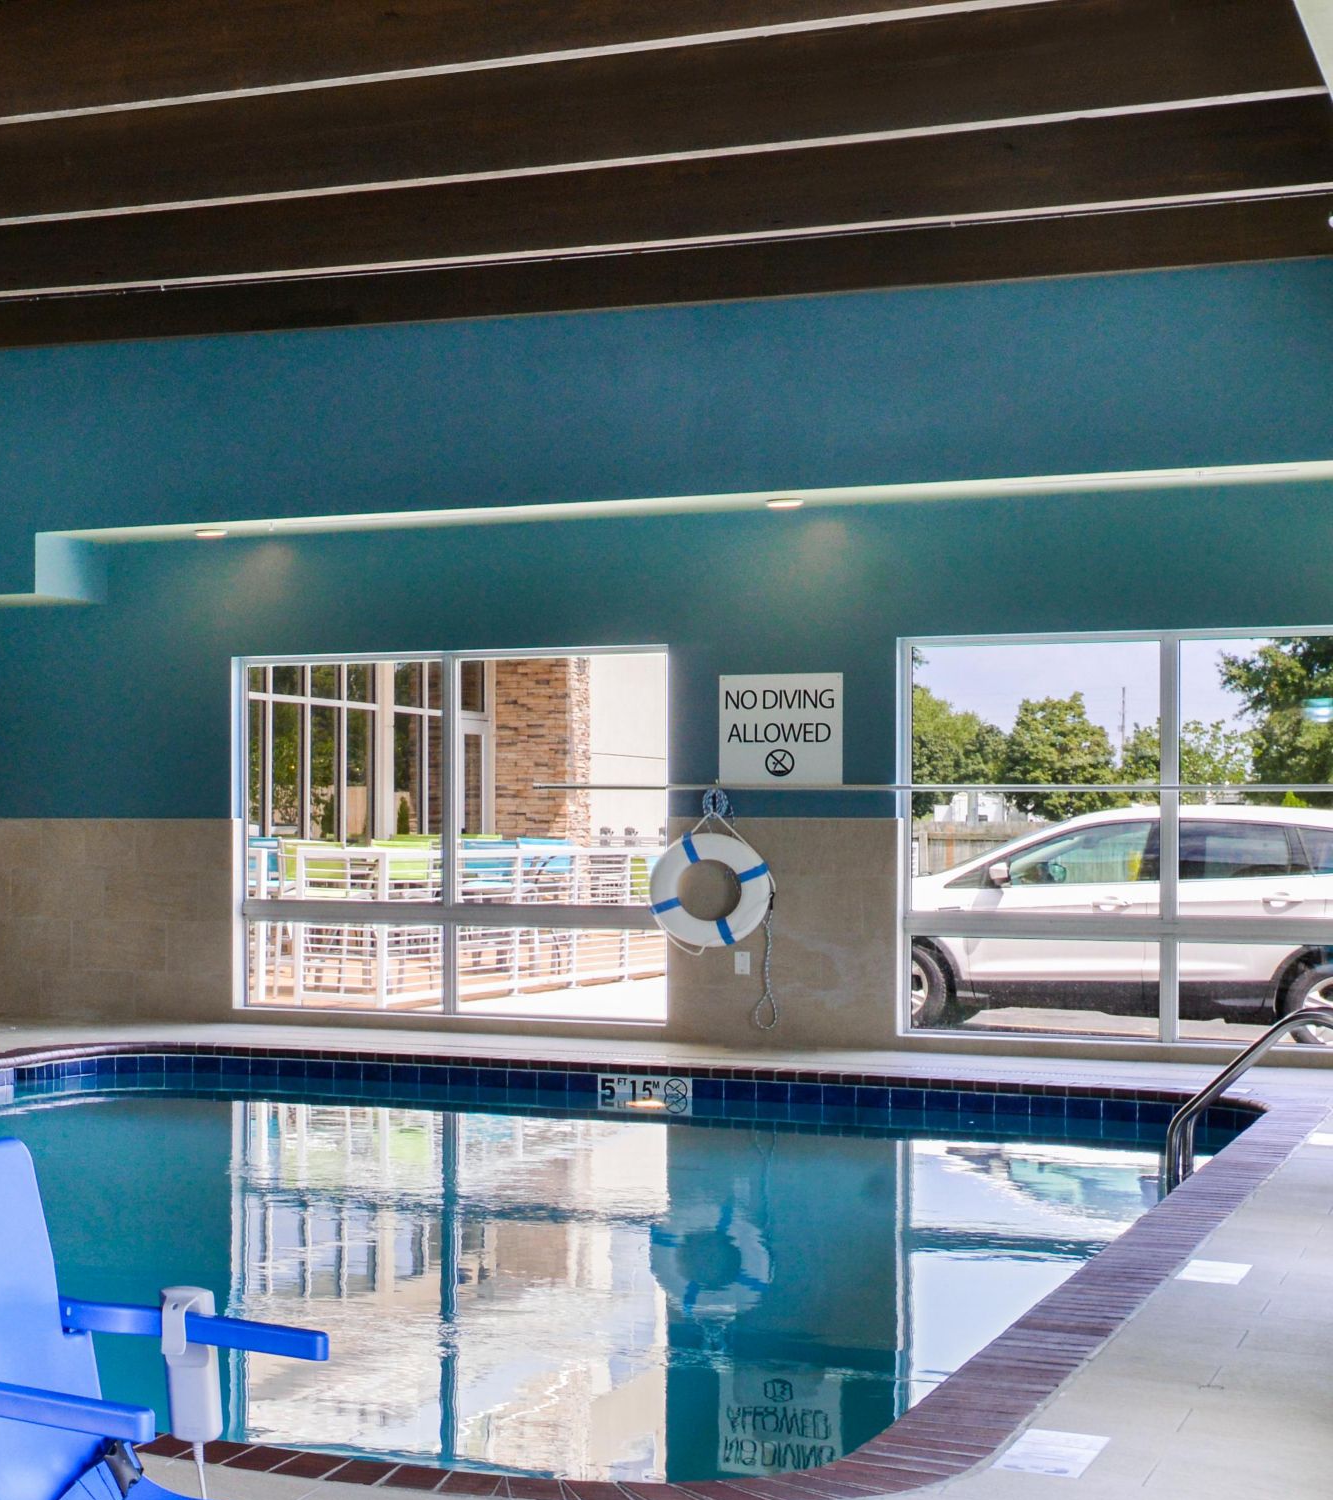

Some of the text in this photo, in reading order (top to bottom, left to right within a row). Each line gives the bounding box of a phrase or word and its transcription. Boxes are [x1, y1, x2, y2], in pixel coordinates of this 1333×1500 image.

[725, 689, 834, 710] NO DIVING
[727, 723, 831, 743] ALLOWED
[618, 1078, 627, 1086] FT
